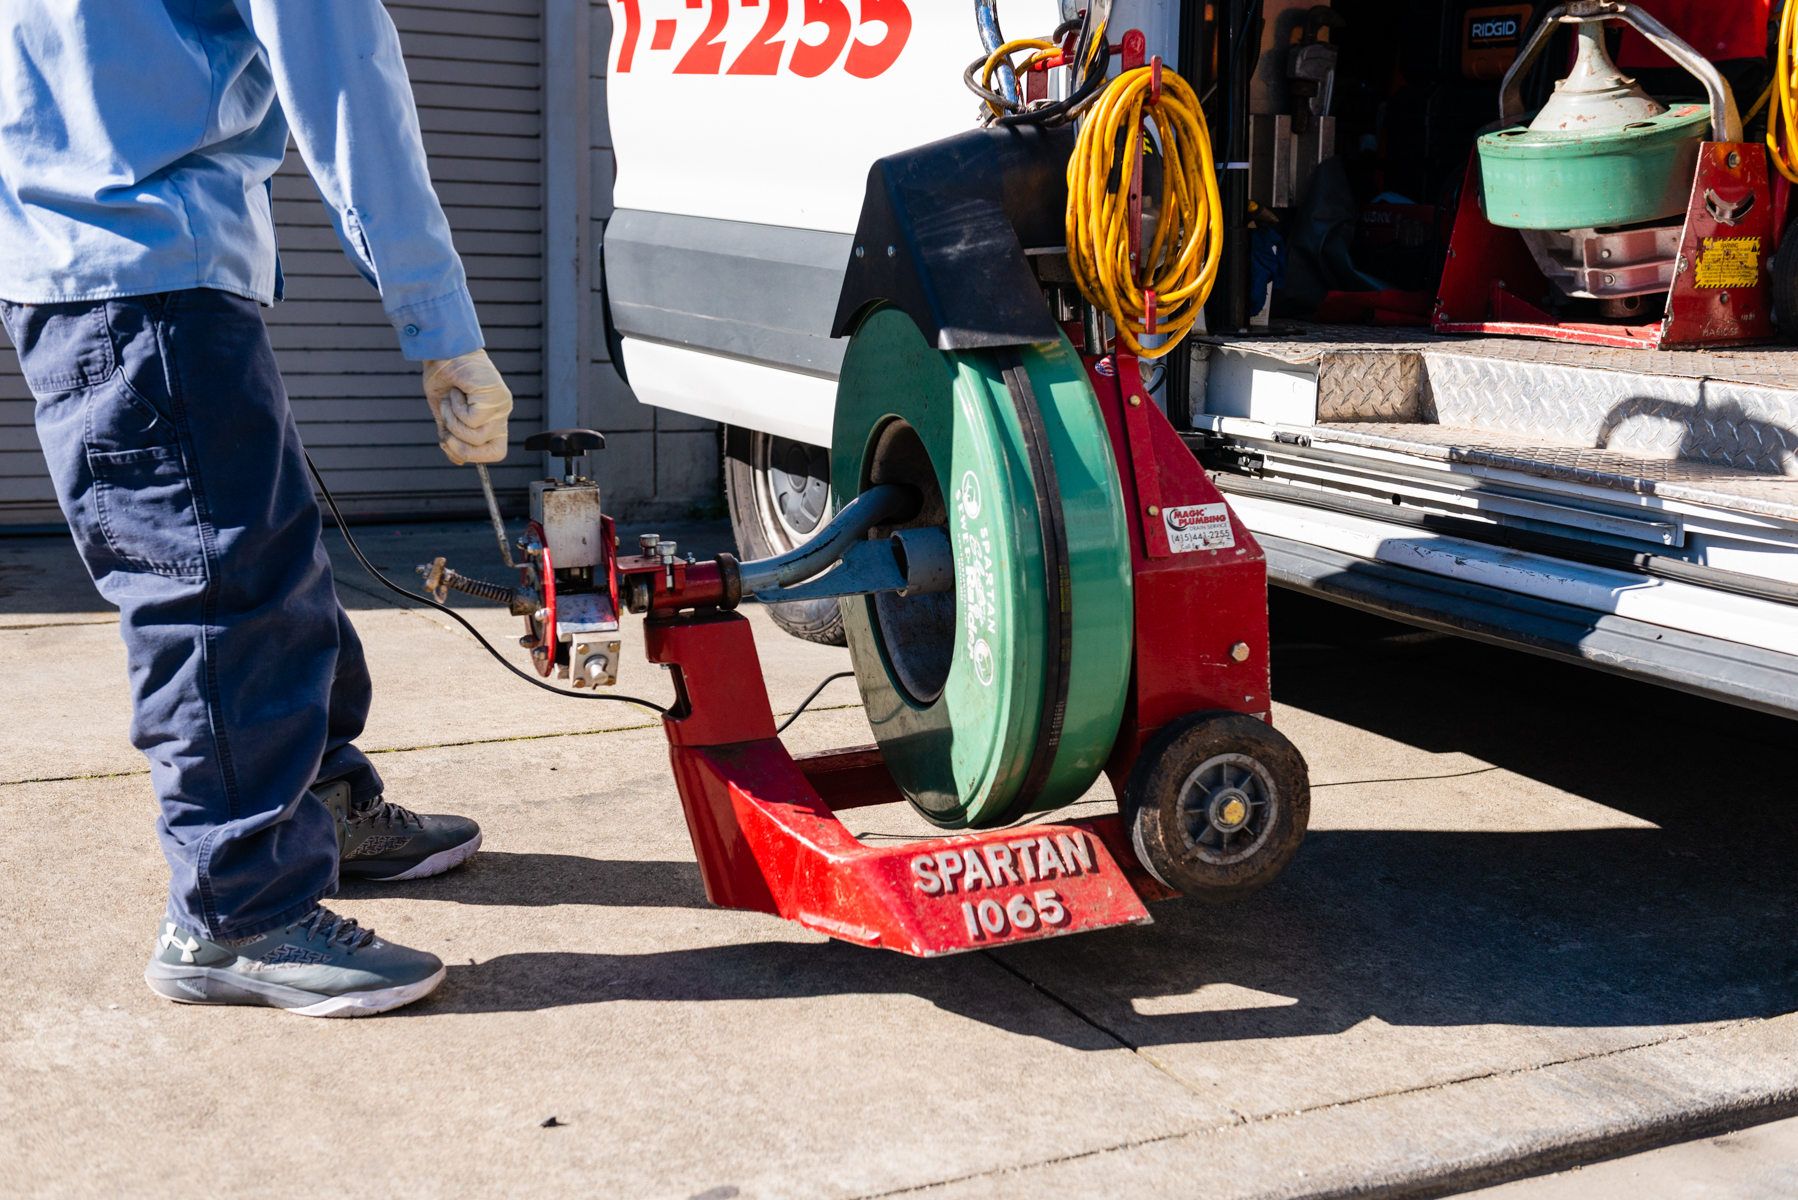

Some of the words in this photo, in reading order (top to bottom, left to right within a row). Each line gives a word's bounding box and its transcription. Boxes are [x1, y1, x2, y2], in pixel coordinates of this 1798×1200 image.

[1472, 21, 1516, 37] RIDGID
[1174, 509, 1205, 519] MAGIC
[1178, 515, 1226, 526] PLUMBING
[979, 527, 995, 634] SPARTAN
[913, 831, 1093, 893] SPARTAN
[962, 889, 1065, 938] 1065
